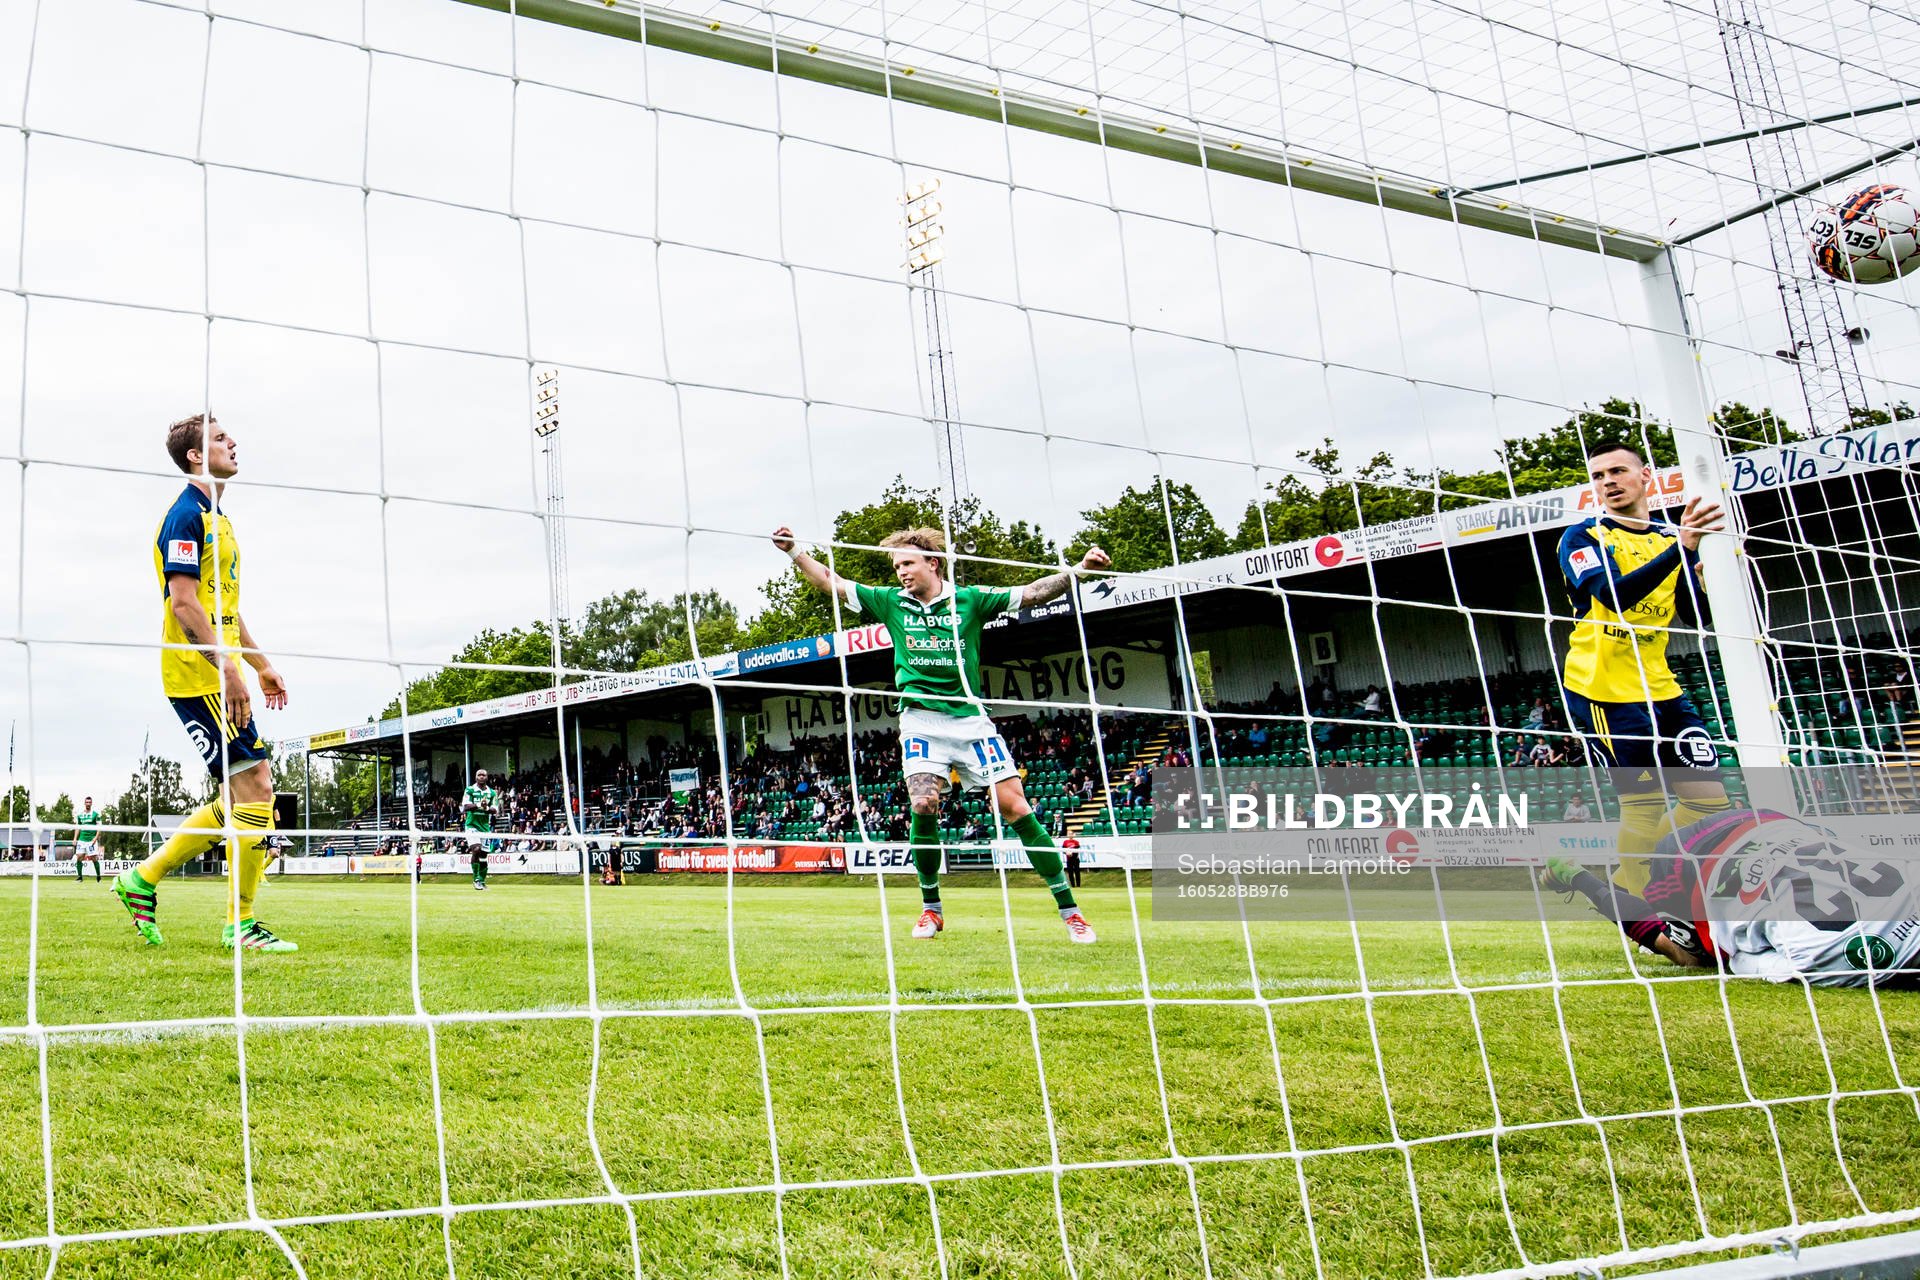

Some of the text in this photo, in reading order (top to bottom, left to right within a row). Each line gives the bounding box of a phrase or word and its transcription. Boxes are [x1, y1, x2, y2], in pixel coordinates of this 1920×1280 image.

[1725, 446, 1818, 492] Bella
[1456, 496, 1564, 531] STARKE ARVID
[1341, 515, 1441, 541] INSTLLATIONSGRUPPE
[1369, 543, 1417, 560] 522-20107
[1114, 588, 1158, 606] BAKER
[983, 618, 1009, 630] ervice
[847, 624, 893, 653] RIC
[744, 645, 810, 669] uddevalla.se
[431, 715, 457, 727] Nordea
[123, 861, 142, 870] BYG
[487, 854, 511, 864] RICOH
[690, 849, 706, 868] för
[705, 850, 738, 868] svenk
[738, 848, 776, 868] fotboll!
